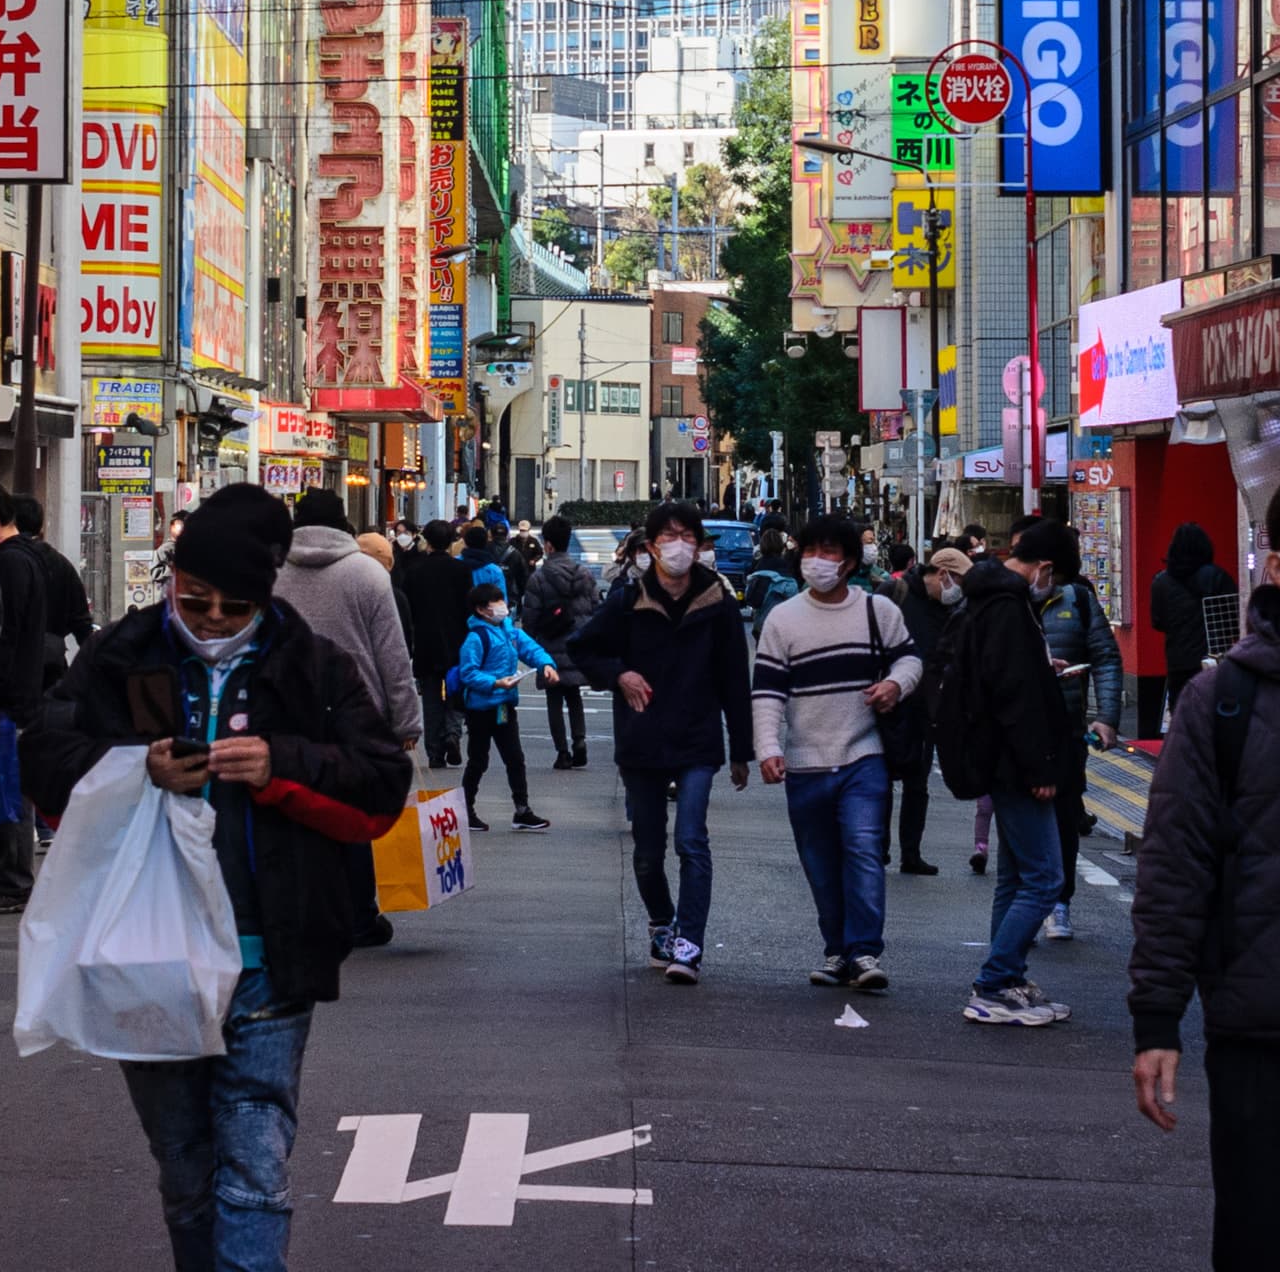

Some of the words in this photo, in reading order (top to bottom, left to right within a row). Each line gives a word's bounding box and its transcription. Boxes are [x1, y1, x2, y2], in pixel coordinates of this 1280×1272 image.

[951, 62, 966, 71] FIRE
[967, 62, 998, 71] HYDRANT
[946, 75, 1006, 103] 消火栓
[914, 112, 934, 130] の
[896, 138, 952, 166] 西川
